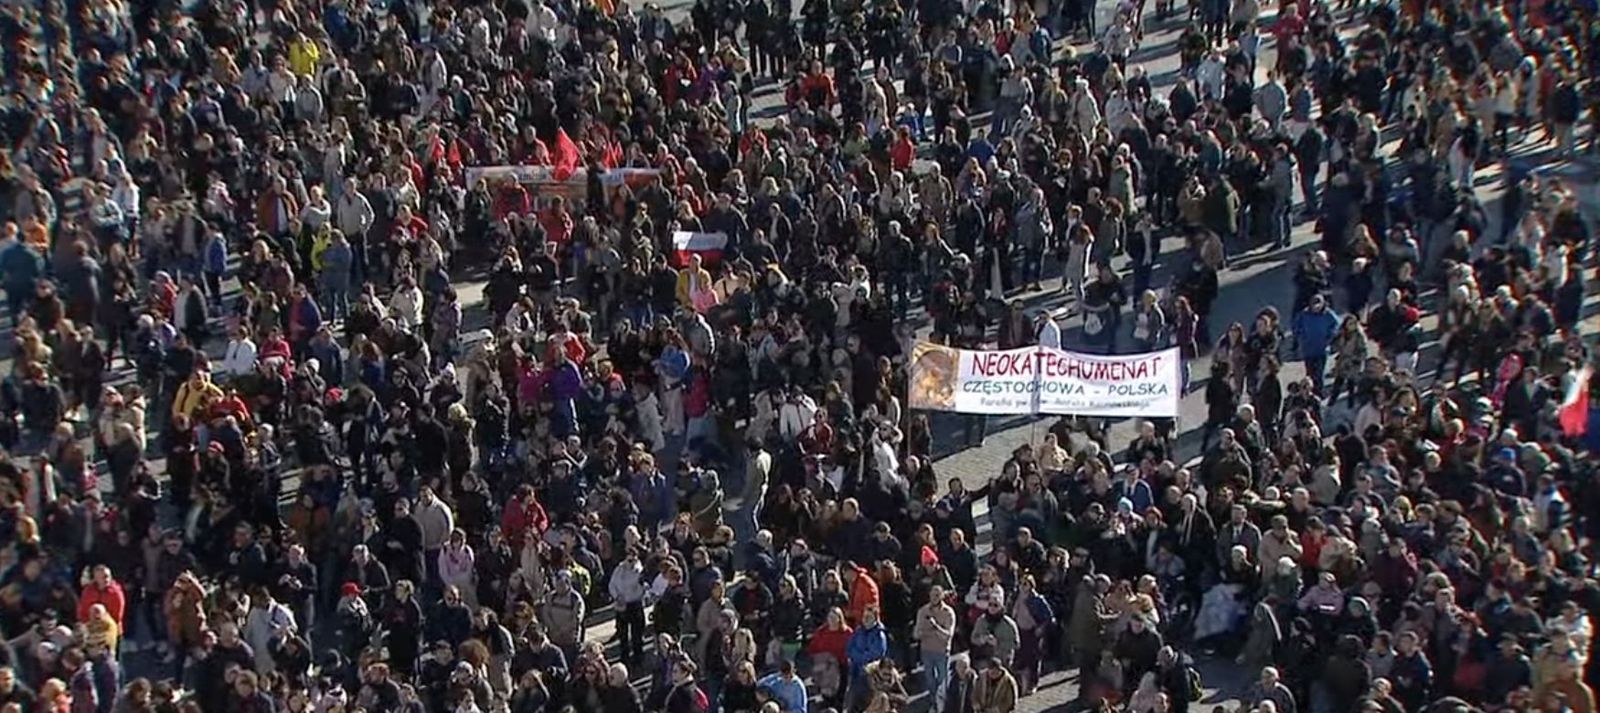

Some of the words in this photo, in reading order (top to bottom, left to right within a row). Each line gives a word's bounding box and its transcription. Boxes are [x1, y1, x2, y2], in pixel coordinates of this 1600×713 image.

[972, 352, 1161, 380] NEOKATECHUMENAT
[963, 381, 1085, 396] CZĘSTOCHOWA
[1107, 384, 1168, 396] POLSKA
